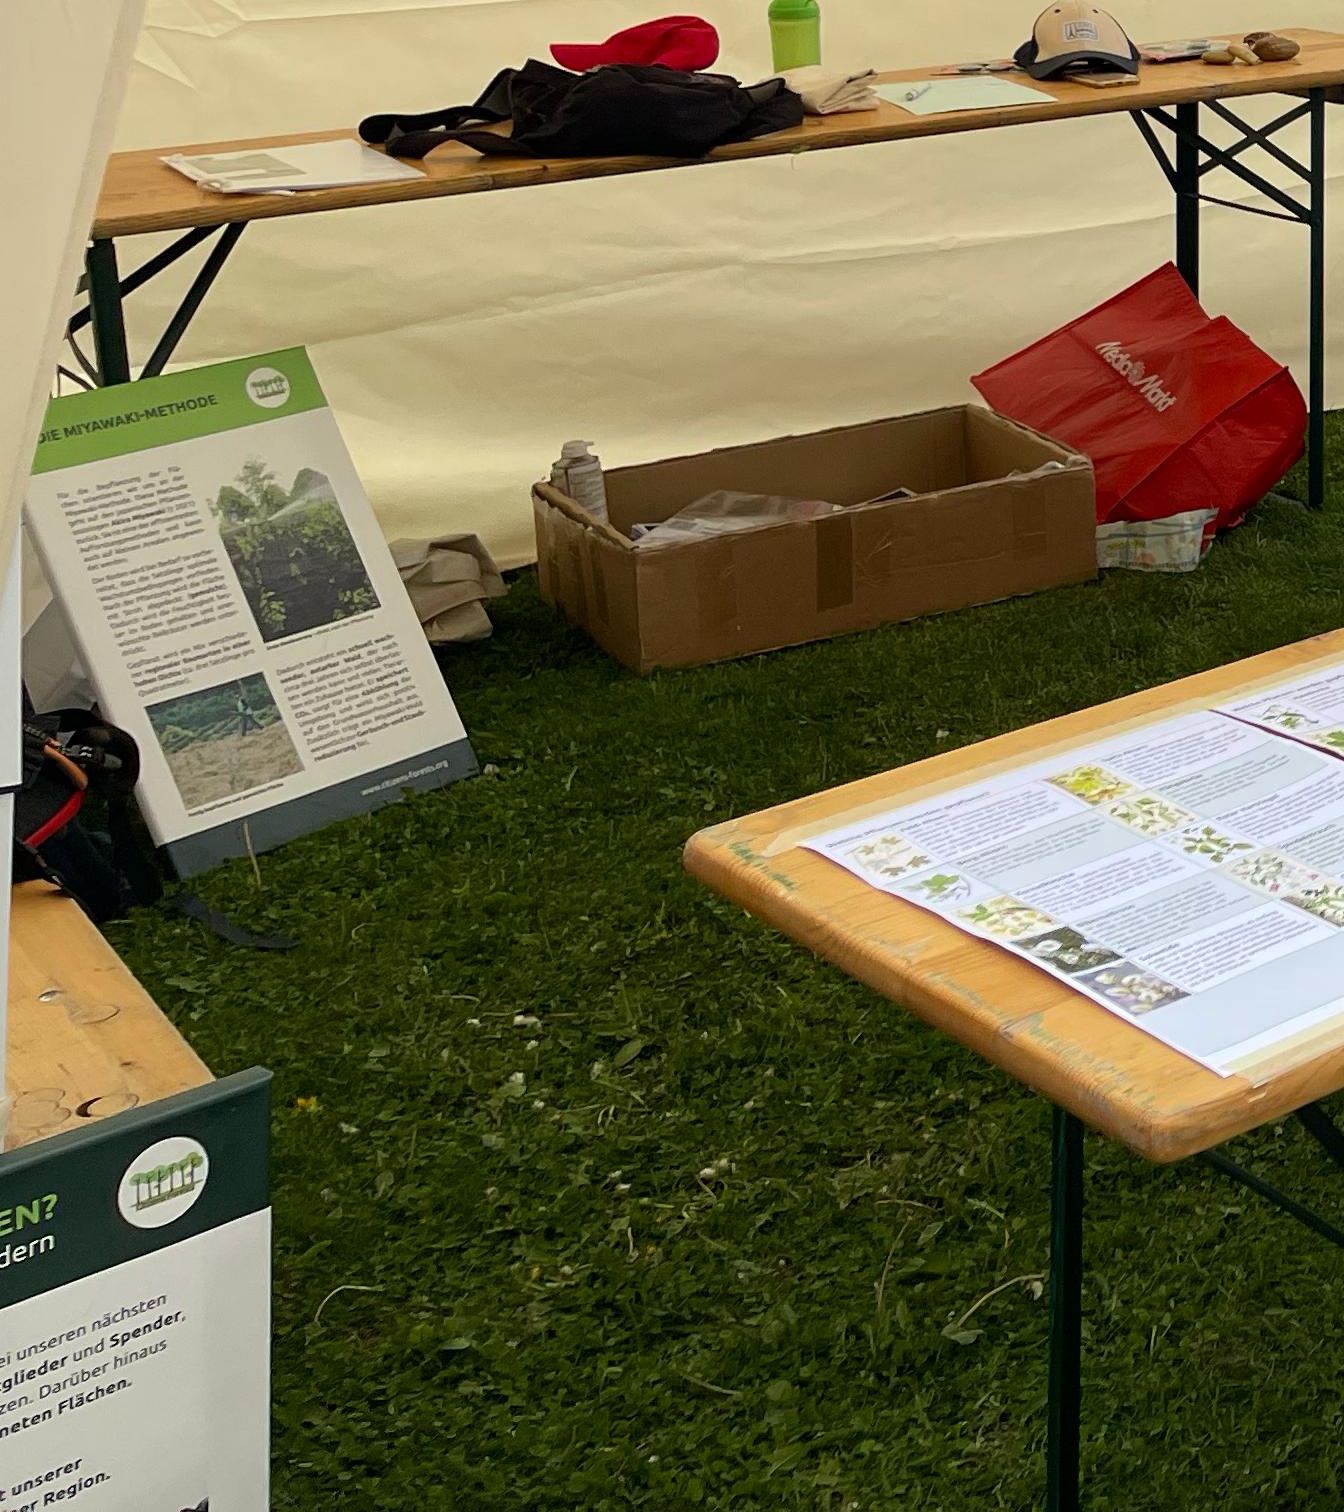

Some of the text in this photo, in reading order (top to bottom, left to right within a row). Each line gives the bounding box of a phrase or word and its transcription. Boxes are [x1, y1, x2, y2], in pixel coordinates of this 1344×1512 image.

[64, 394, 219, 439] MIYAWAKI-METHODE
[16, 1324, 87, 1361] unseren
[91, 1294, 168, 1333] nächsten
[73, 1337, 104, 1362] und
[110, 1310, 187, 1349] Spender,
[39, 1361, 109, 1400] Darüber
[113, 1339, 168, 1369] hinaus
[58, 1377, 133, 1415] Flächen.
[12, 1457, 83, 1497] unserer
[43, 1471, 112, 1507] Region.
